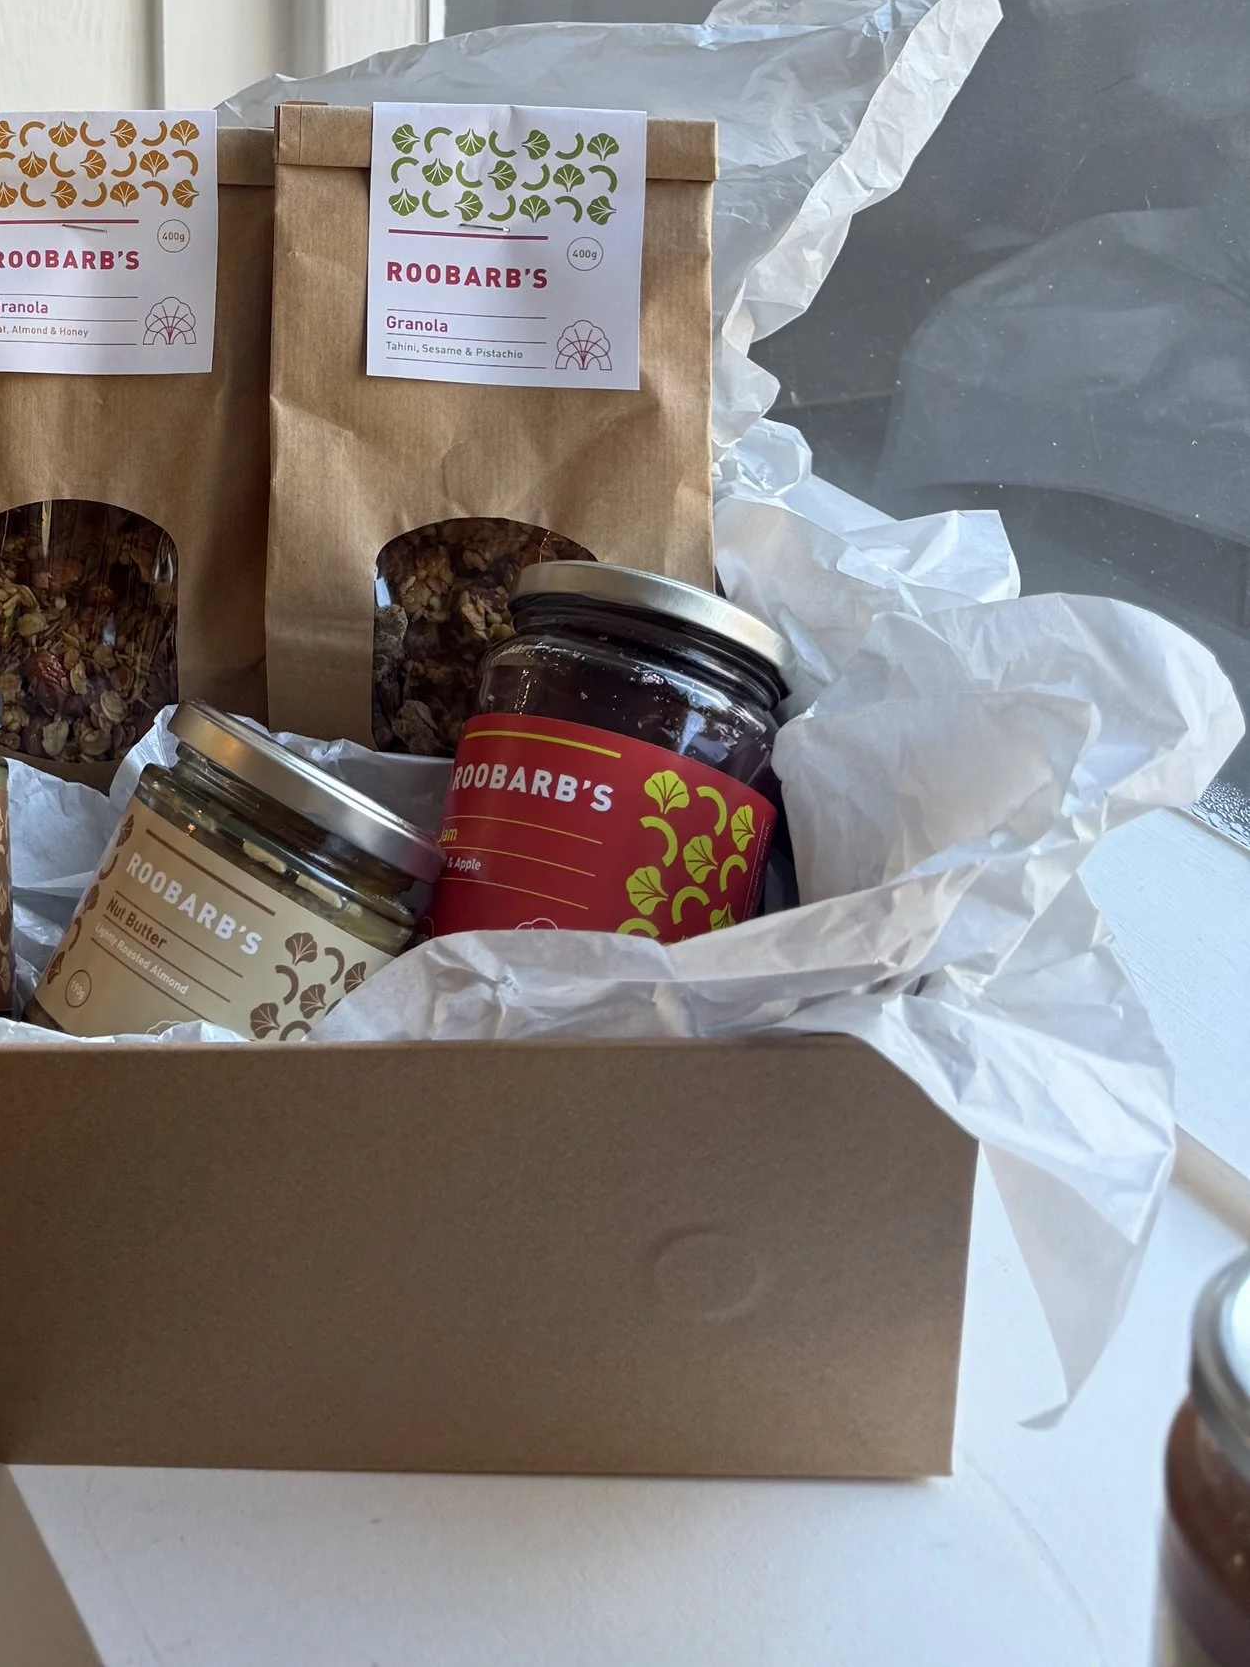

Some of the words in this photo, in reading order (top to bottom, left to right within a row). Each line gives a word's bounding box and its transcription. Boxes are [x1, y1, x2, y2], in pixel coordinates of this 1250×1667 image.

[162, 232, 185, 243] 400g
[572, 249, 598, 260] 400g
[387, 261, 548, 289] ROOBARB'S
[12, 325, 48, 335] Almond
[50, 327, 57, 335] &
[59, 327, 89, 338] Honey
[386, 315, 448, 333] Granola
[386, 341, 420, 354] Tahini,
[422, 344, 462, 356] Sesame
[465, 347, 472, 356] &
[475, 348, 523, 359] Pistachio
[452, 762, 614, 812] ROOBARB'S
[454, 858, 481, 872] Apple
[125, 852, 263, 956] ROOBARB'S
[106, 898, 126, 921] Nut
[125, 912, 168, 949] Butter
[117, 940, 151, 970] Roasted
[150, 965, 189, 995] Almond
